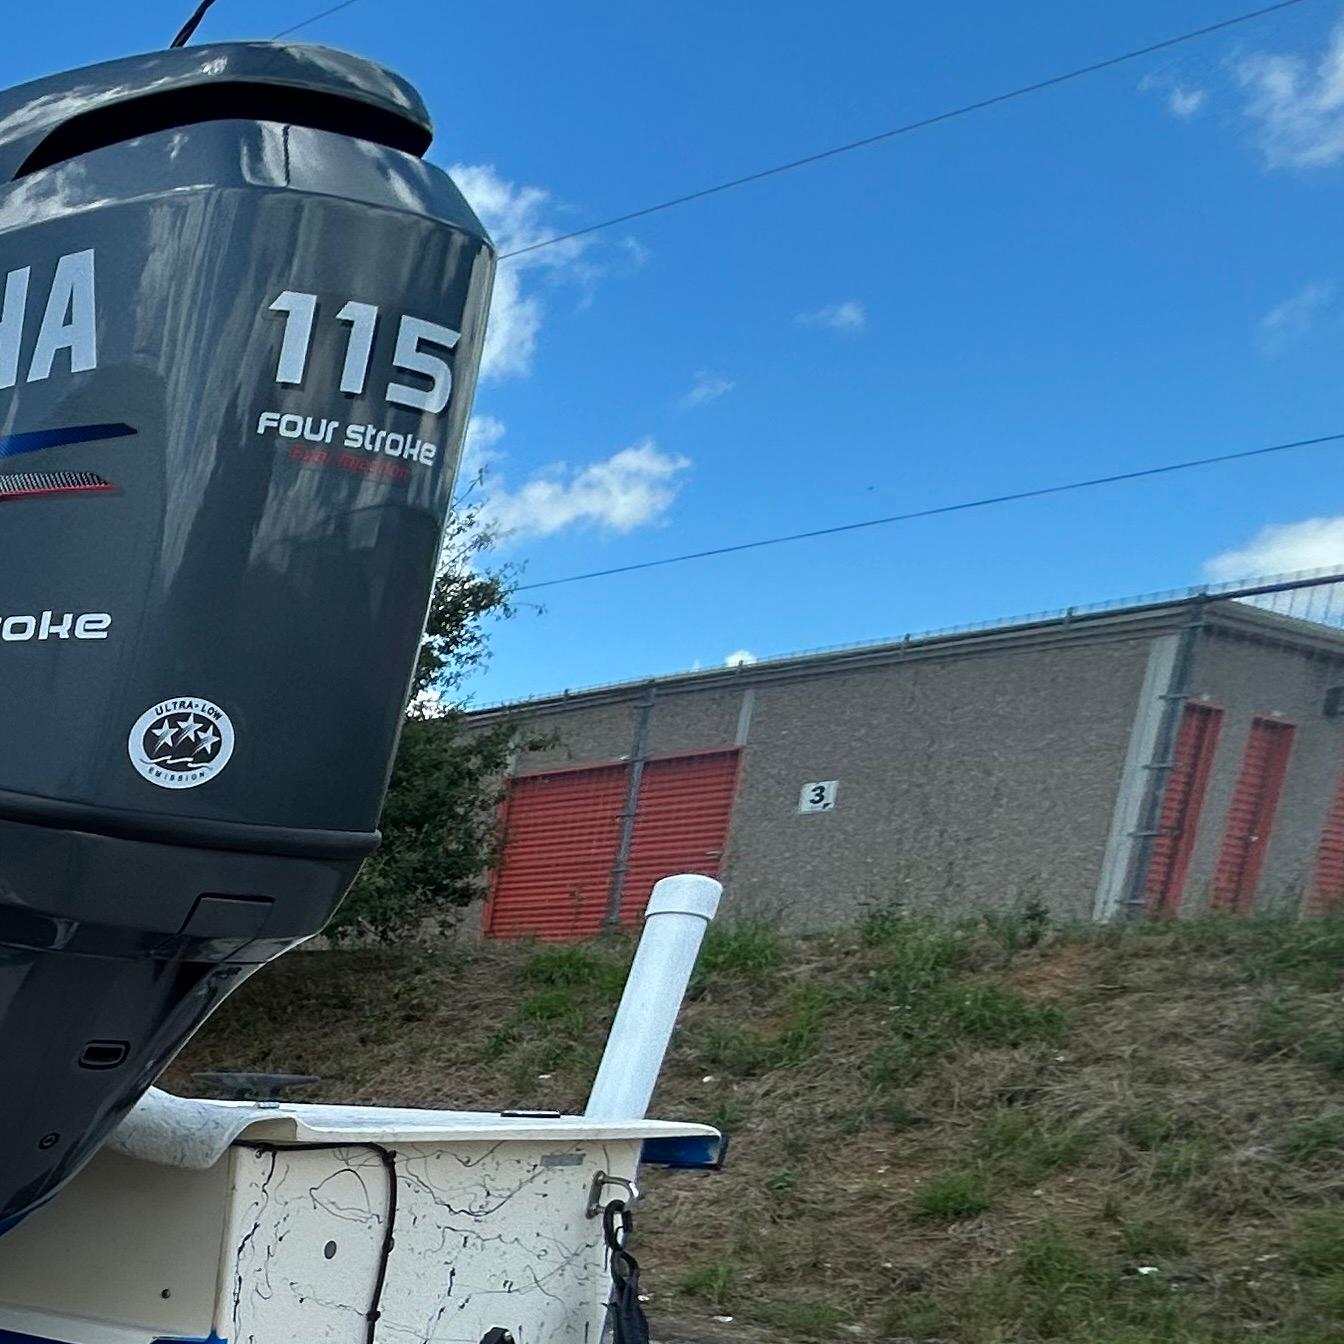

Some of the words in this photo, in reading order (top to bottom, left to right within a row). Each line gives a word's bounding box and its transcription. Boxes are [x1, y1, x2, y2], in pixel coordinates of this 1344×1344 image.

[268, 290, 462, 414] 115
[149, 766, 205, 782] EMISSION
[809, 785, 826, 805] 3
